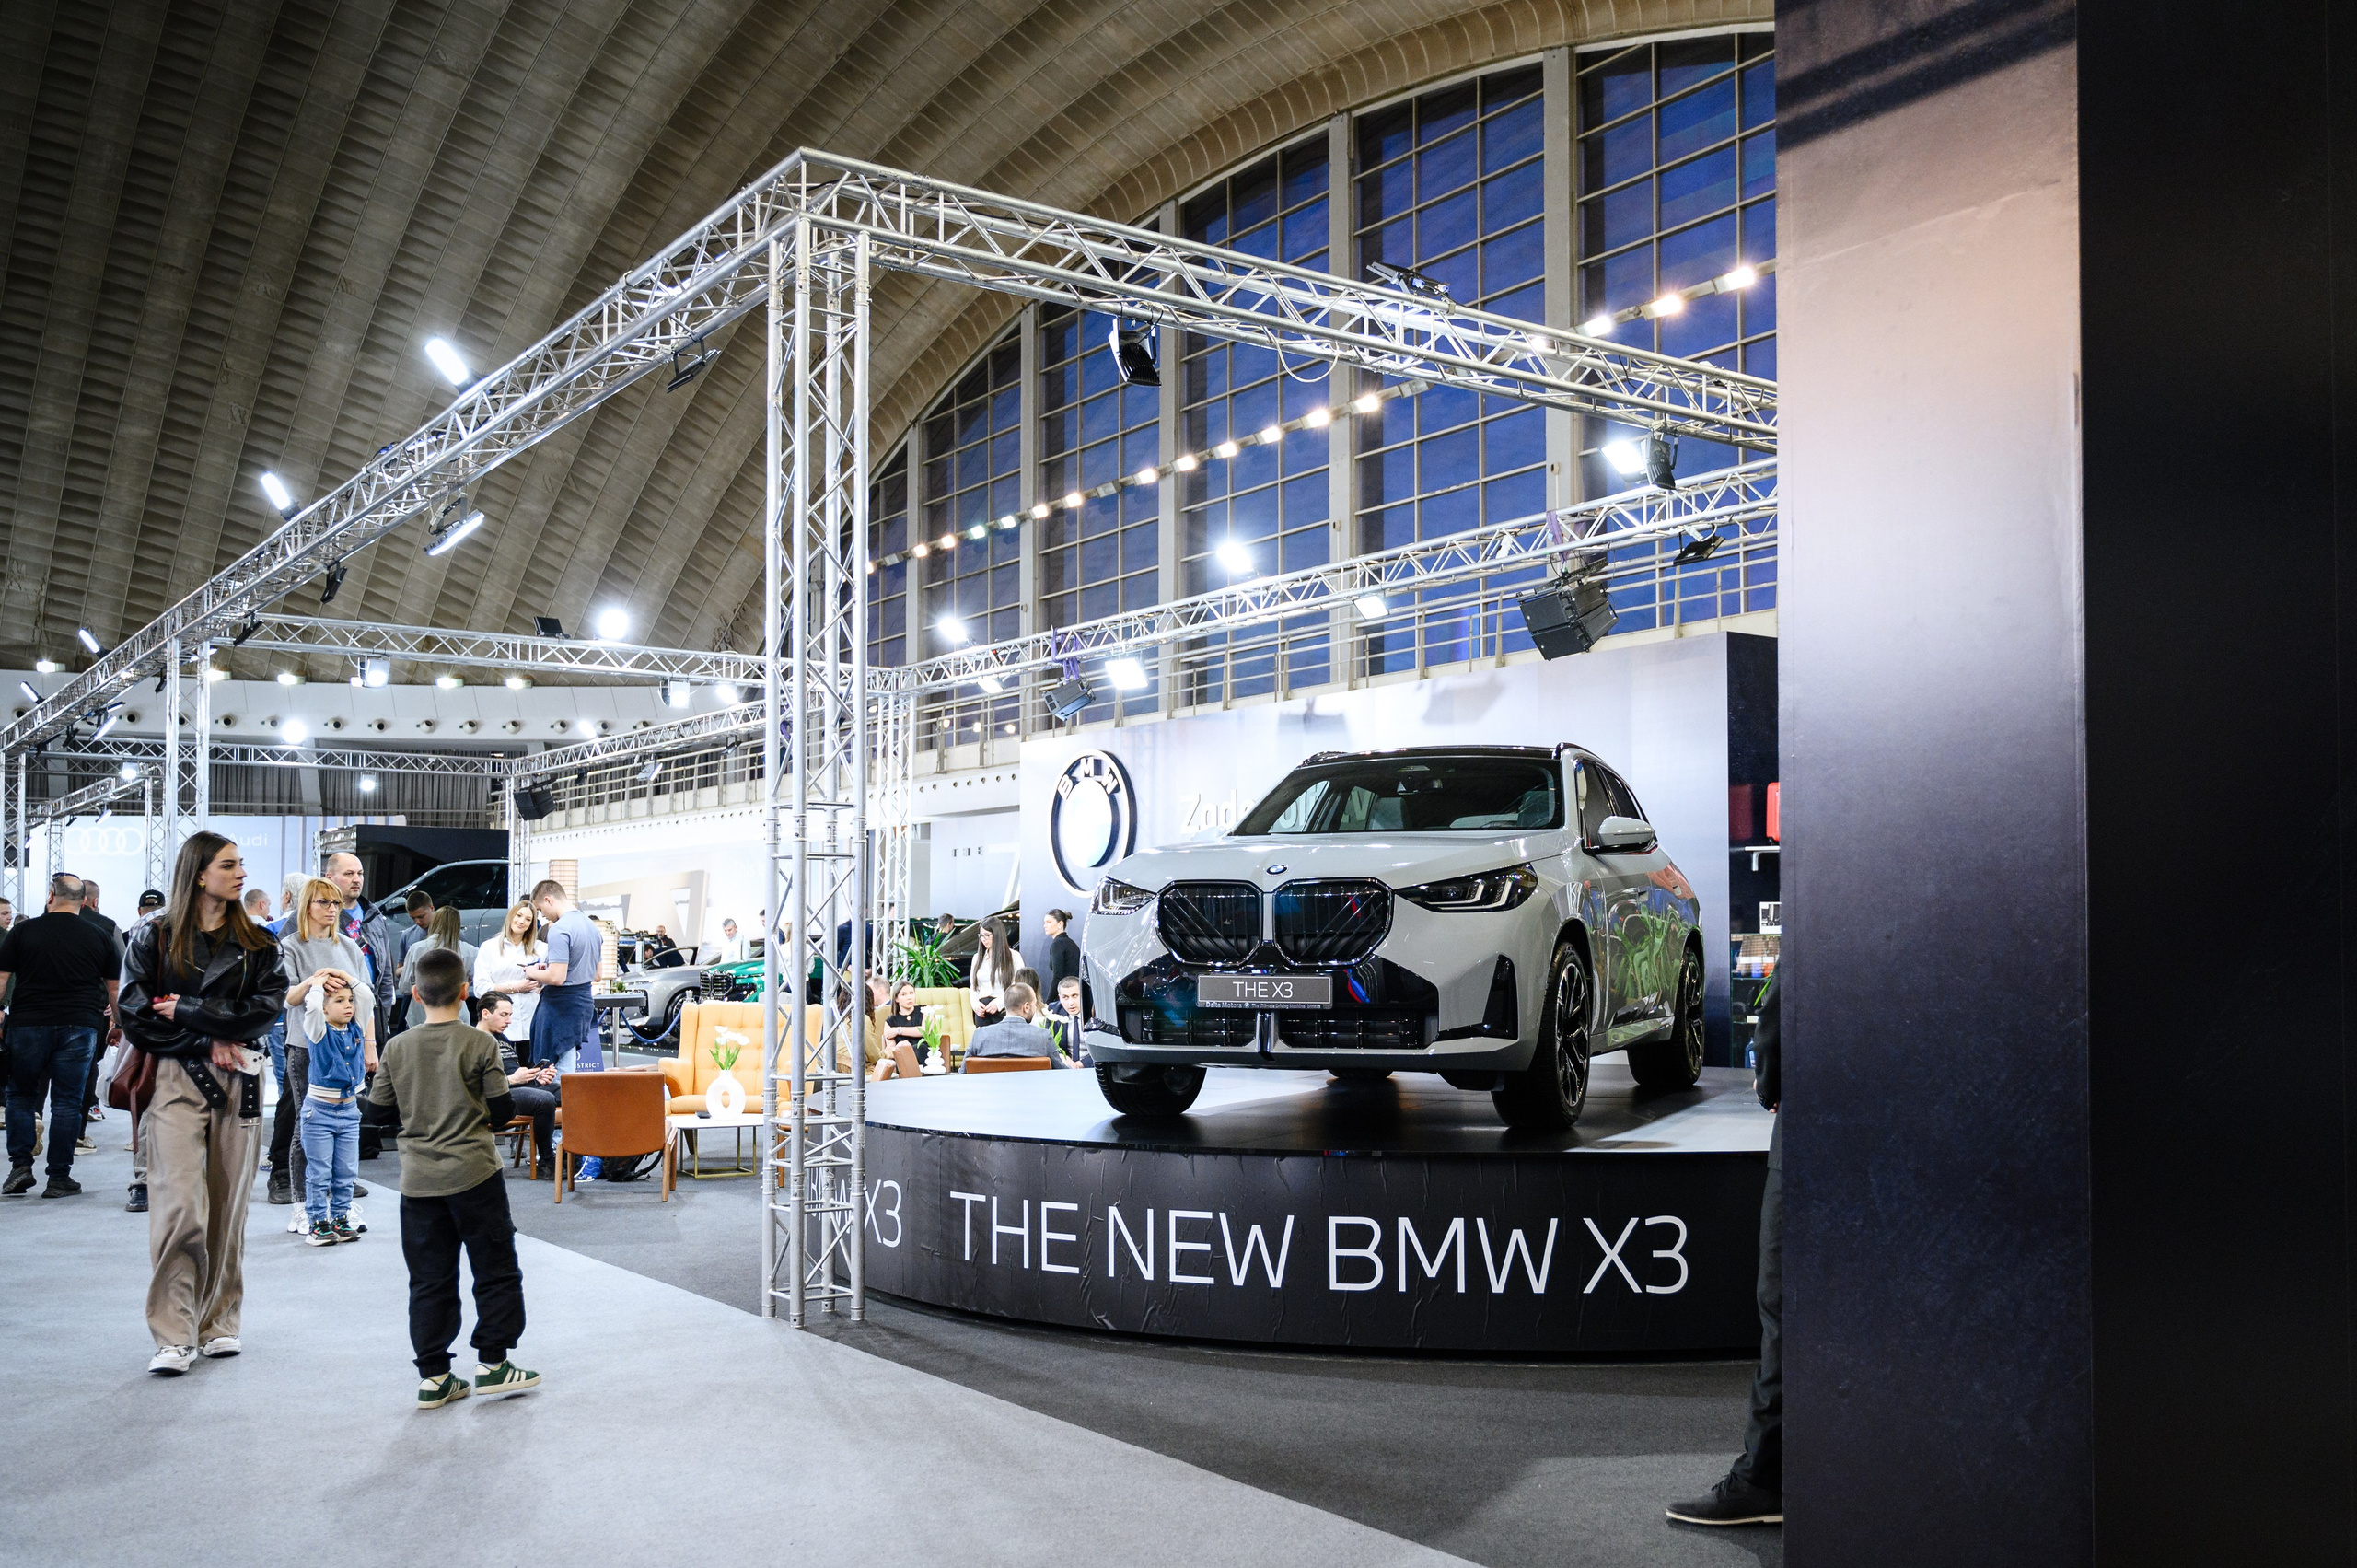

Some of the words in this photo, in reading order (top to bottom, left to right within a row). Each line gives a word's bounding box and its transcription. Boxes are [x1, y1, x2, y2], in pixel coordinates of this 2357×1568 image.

[1057, 756, 1118, 800] BMW
[229, 833, 268, 846] Audi
[1222, 1001, 1242, 1009] Motors
[1233, 981, 1269, 998] THE
[1272, 982, 1294, 999] X3
[865, 1179, 902, 1248] X3
[950, 1191, 1080, 1274] THE
[1108, 1205, 1295, 1288] NEW
[1329, 1215, 1559, 1294] BMW
[1583, 1214, 1689, 1294] X3
